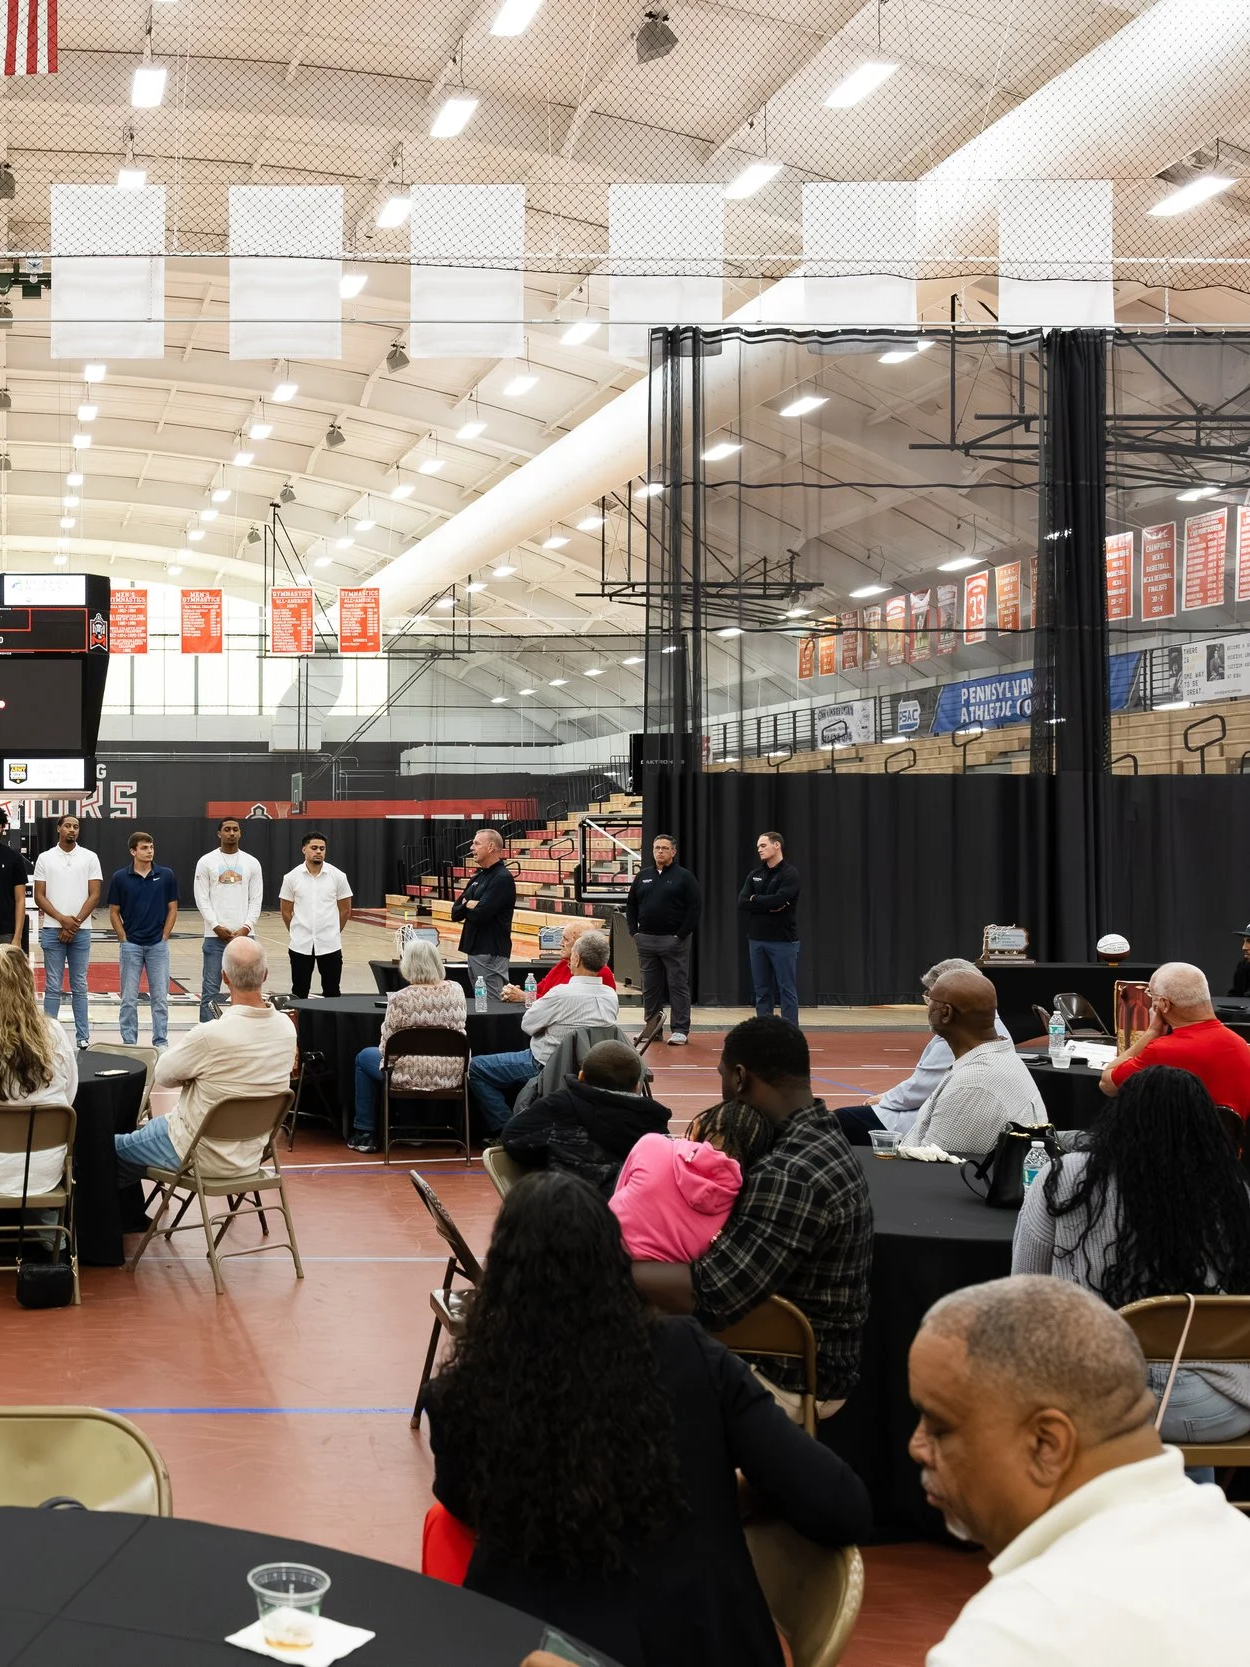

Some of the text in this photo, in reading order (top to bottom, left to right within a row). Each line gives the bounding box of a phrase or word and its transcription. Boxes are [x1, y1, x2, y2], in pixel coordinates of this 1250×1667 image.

[1146, 541, 1171, 552] CHAMPIONS
[970, 594, 985, 622] 33
[1183, 646, 1198, 654] THERE
[961, 677, 1033, 704] PENNSYLVAN
[961, 700, 1012, 723] ATHLETIC
